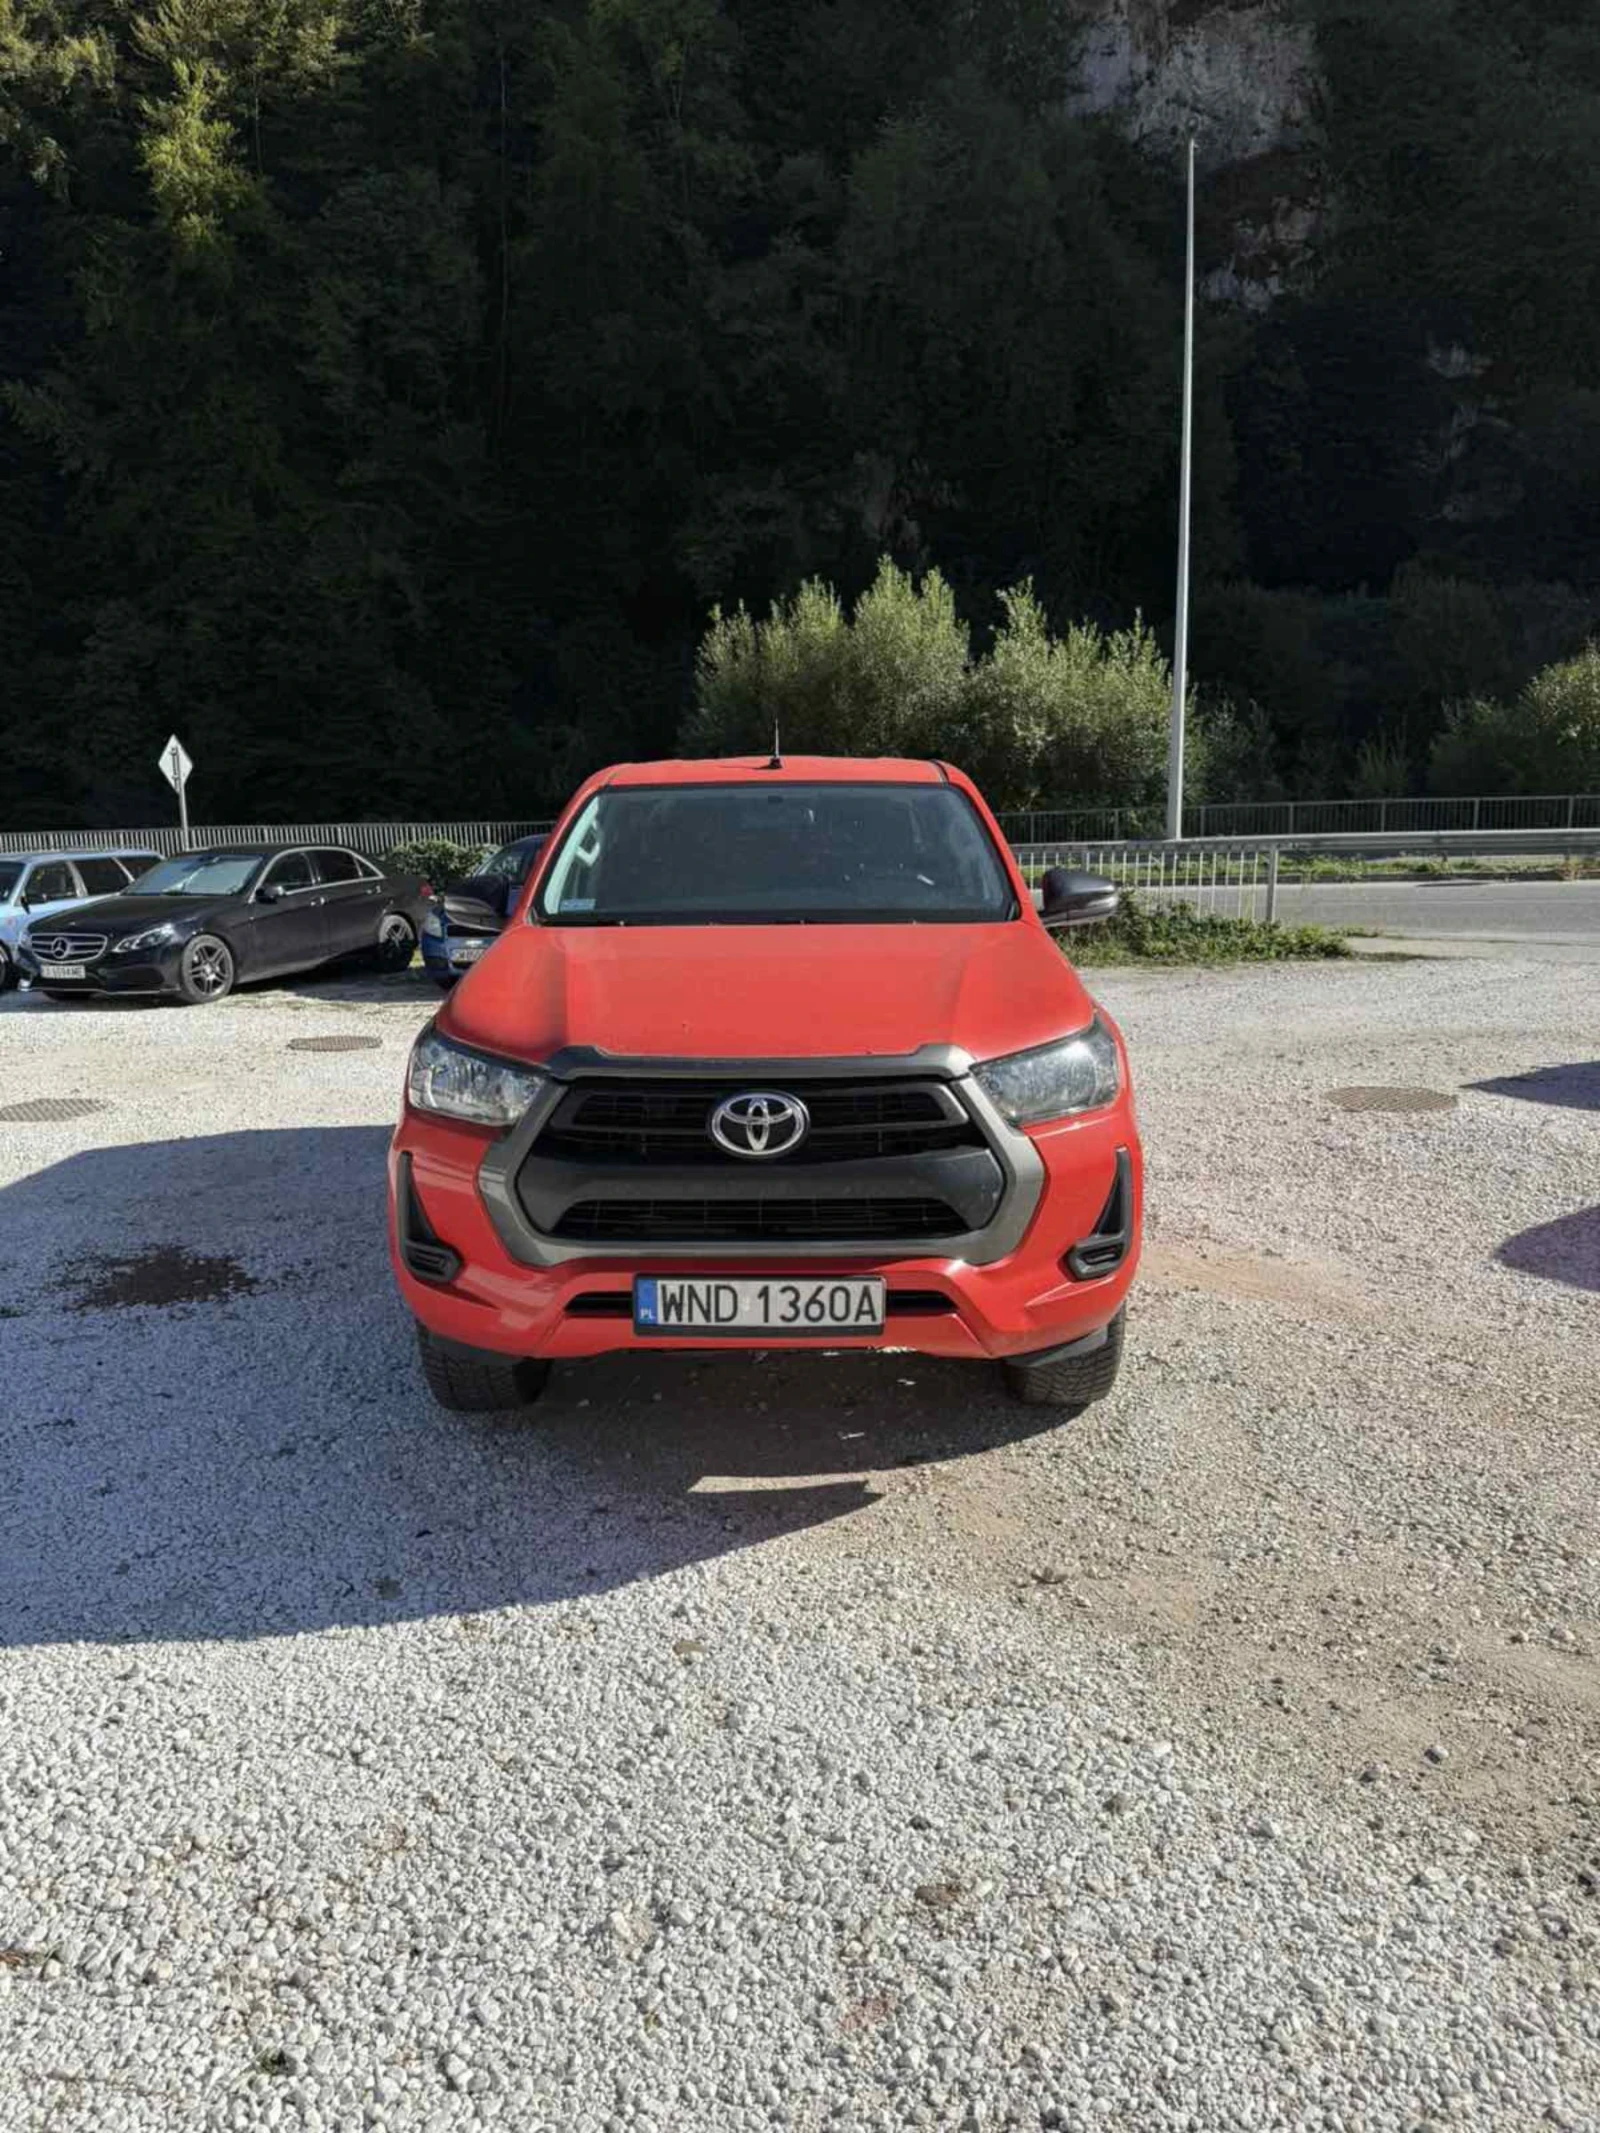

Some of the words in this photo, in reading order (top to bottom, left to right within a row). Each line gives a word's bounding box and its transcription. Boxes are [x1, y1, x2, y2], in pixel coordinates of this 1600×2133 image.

[640, 1308, 656, 1320] PL
[661, 1284, 738, 1323] WND
[757, 1285, 877, 1323] 1360A
